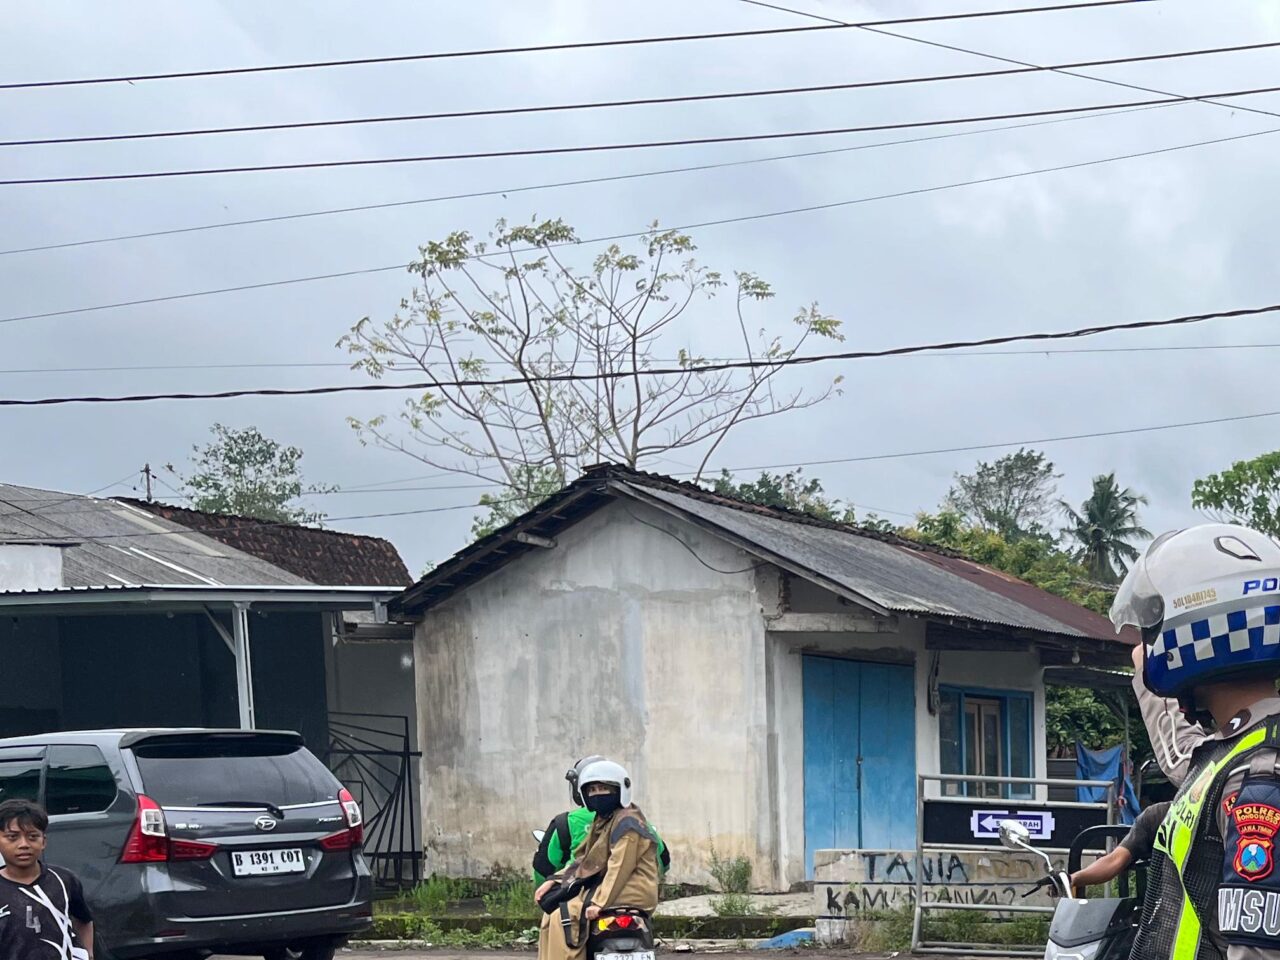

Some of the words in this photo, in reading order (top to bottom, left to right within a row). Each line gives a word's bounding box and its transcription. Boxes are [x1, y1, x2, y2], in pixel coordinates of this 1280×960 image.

[234, 853, 243, 866] B
[249, 852, 275, 865] 1391
[861, 852, 969, 882] TANIA
[26, 905, 41, 933] 4
